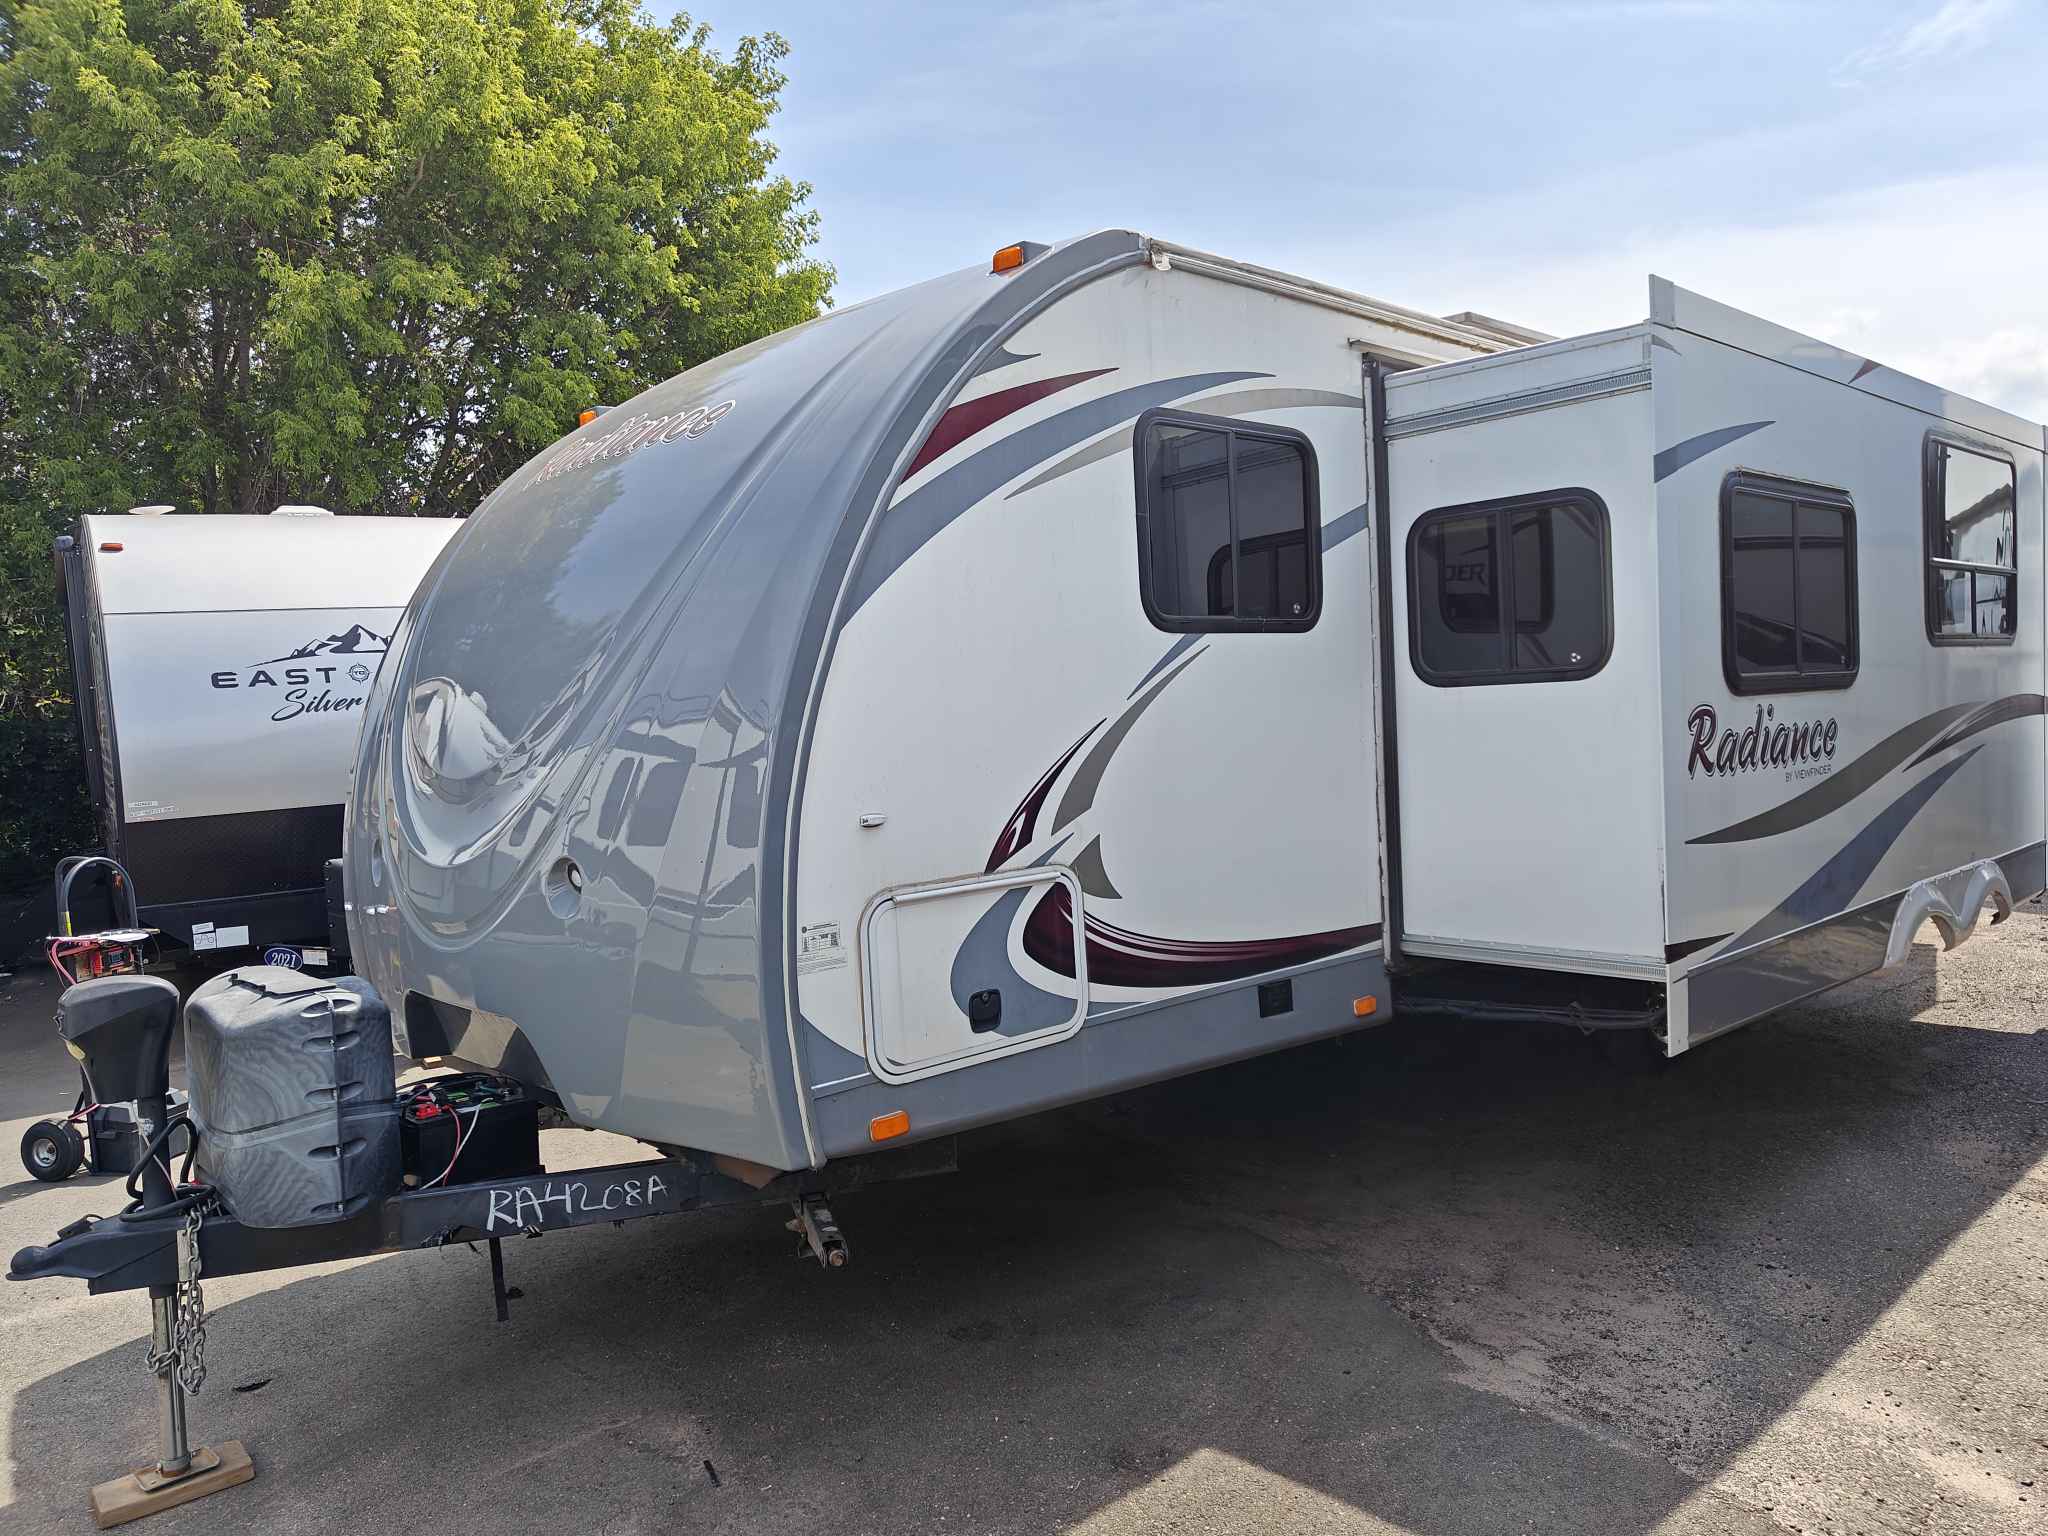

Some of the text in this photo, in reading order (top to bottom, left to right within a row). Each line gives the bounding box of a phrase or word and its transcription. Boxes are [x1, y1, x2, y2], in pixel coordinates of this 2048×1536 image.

[211, 667, 337, 689] EAST
[271, 688, 364, 722] Silver
[1687, 703, 1838, 780] Radiance
[271, 952, 297, 968] 2021
[486, 1174, 669, 1232] RA4208A
